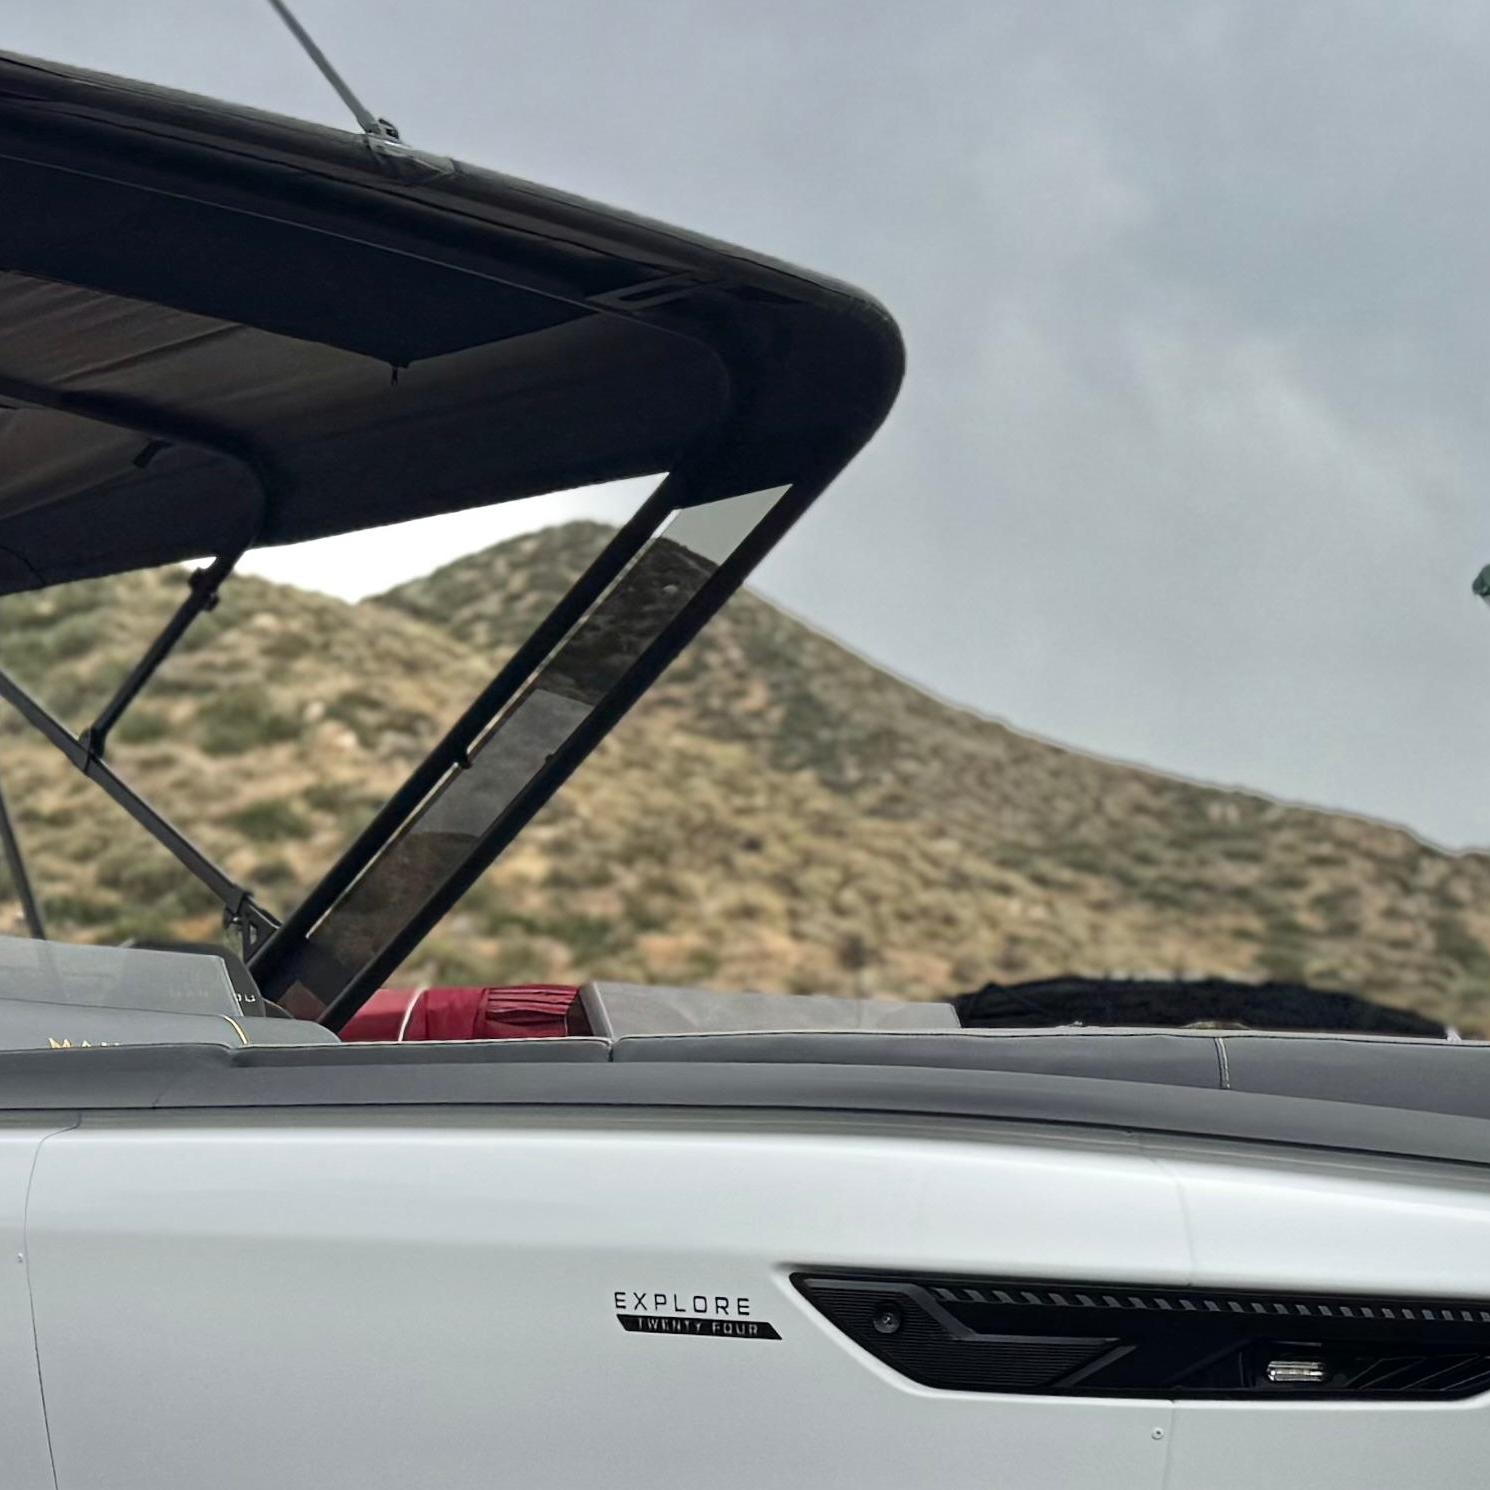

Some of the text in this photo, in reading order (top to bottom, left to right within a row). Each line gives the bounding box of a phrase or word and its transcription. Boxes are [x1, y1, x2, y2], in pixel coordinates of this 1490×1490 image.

[614, 1291, 751, 1316] EXPLORE
[637, 1316, 759, 1336] TWENTY FOUR
